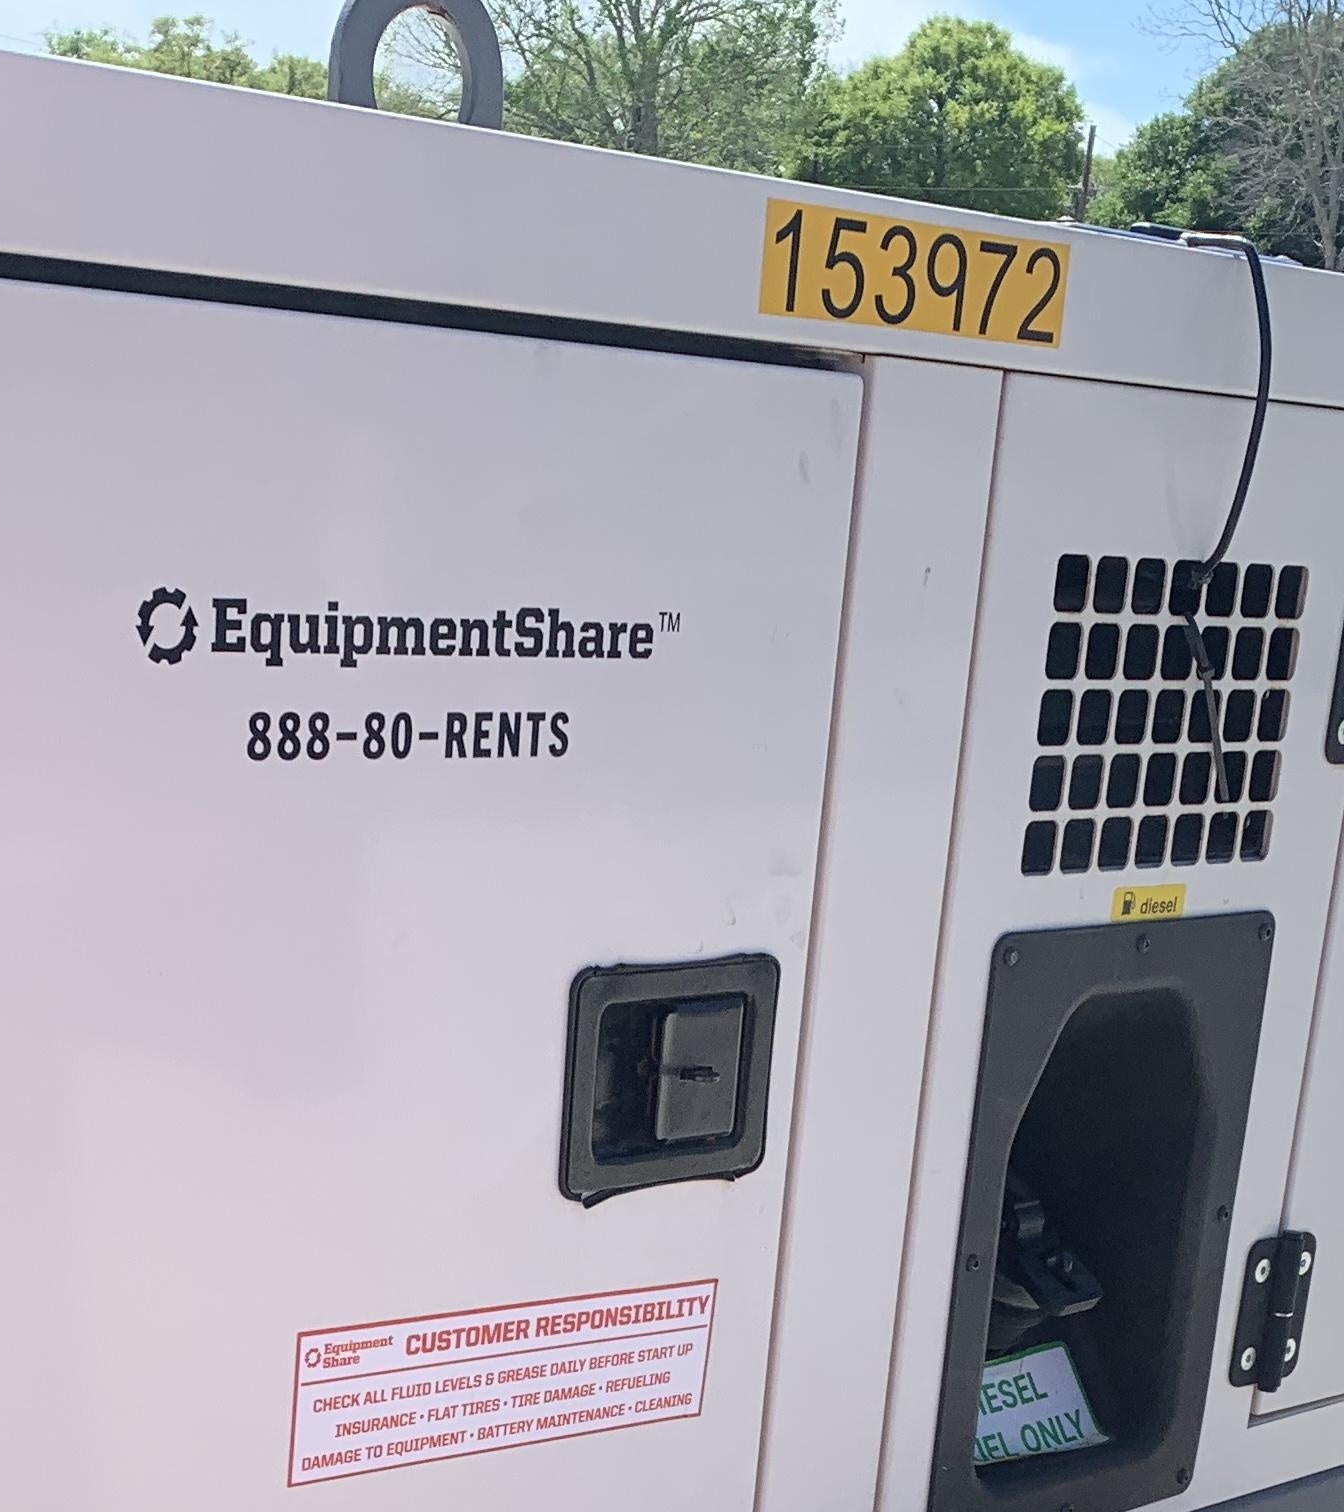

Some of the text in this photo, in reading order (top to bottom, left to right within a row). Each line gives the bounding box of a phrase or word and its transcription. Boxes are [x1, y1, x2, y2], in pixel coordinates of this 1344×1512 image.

[774, 208, 1061, 344] 153972
[210, 596, 655, 669] EquipmentShare
[246, 710, 571, 762] 888-80-RENTS
[1139, 895, 1178, 915] diesel
[323, 1335, 394, 1356] Equipment
[405, 1294, 711, 1356] CUSTOMER RESPONSIBILITY
[313, 1393, 361, 1413] CHECK
[363, 1388, 388, 1406] ALL
[391, 1382, 432, 1401] FLUID
[435, 1374, 483, 1394] LEVELS
[497, 1363, 548, 1384] GREASE
[550, 1358, 587, 1377] DAILY
[589, 1351, 636, 1371] BEFORE
[637, 1344, 674, 1363] START
[677, 1343, 694, 1357] UP
[322, 1352, 361, 1369] Share
[334, 1371, 672, 1438] INSURANCE FLAT TIRES TIRE DAMAGE REFUELING
[979, 1371, 1049, 1416] IESEL
[301, 1392, 694, 1472] DAMAGE TO EQUIPMENT BATTERY MAINTENANCE CLEANING
[1019, 1408, 1086, 1453] ONLY
